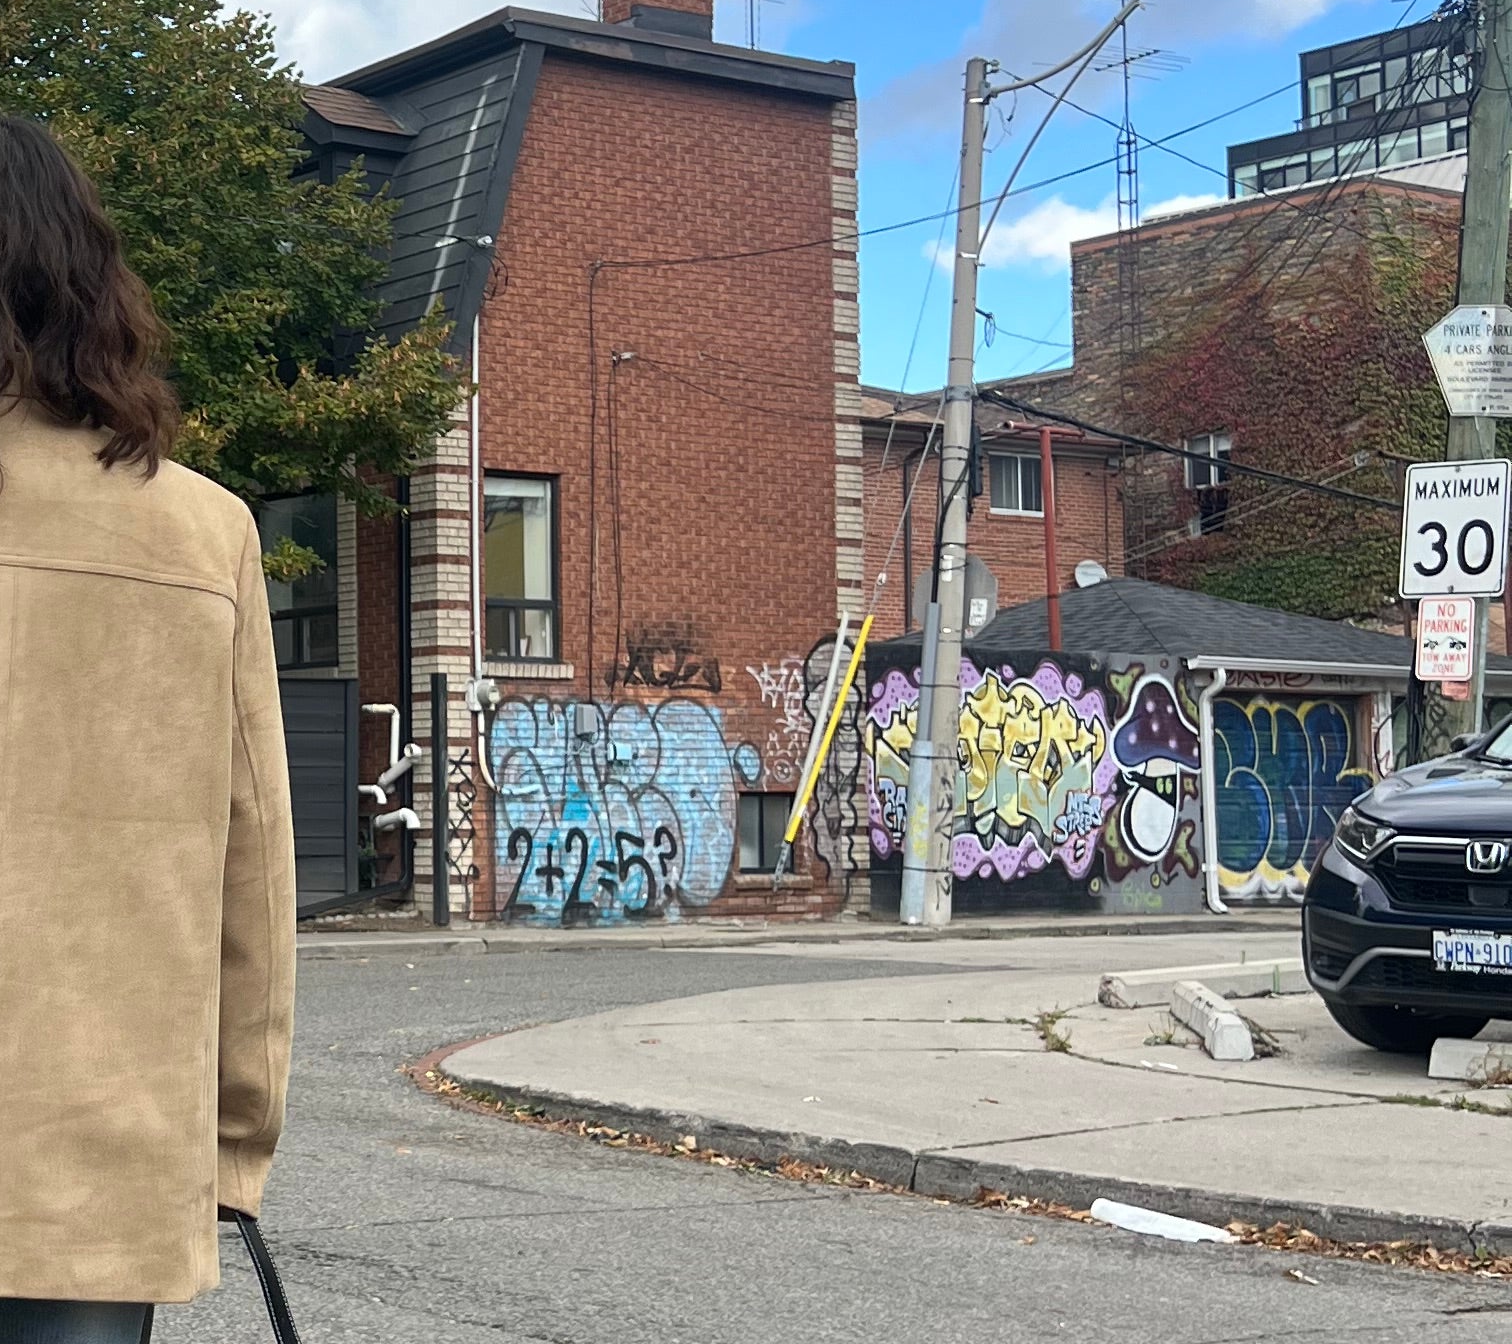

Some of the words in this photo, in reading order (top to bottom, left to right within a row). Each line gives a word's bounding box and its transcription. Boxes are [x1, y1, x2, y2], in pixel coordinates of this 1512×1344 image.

[1443, 324, 1481, 337] PRIVATE
[1456, 344, 1482, 355] CARS
[1415, 477, 1500, 500] MAXIMUM
[1413, 519, 1494, 577] 30
[1437, 603, 1456, 617] NO
[1424, 619, 1467, 633] PARKING
[1423, 654, 1439, 662] TOW
[1444, 654, 1467, 662] AWAY
[1435, 940, 1474, 963] CWPN
